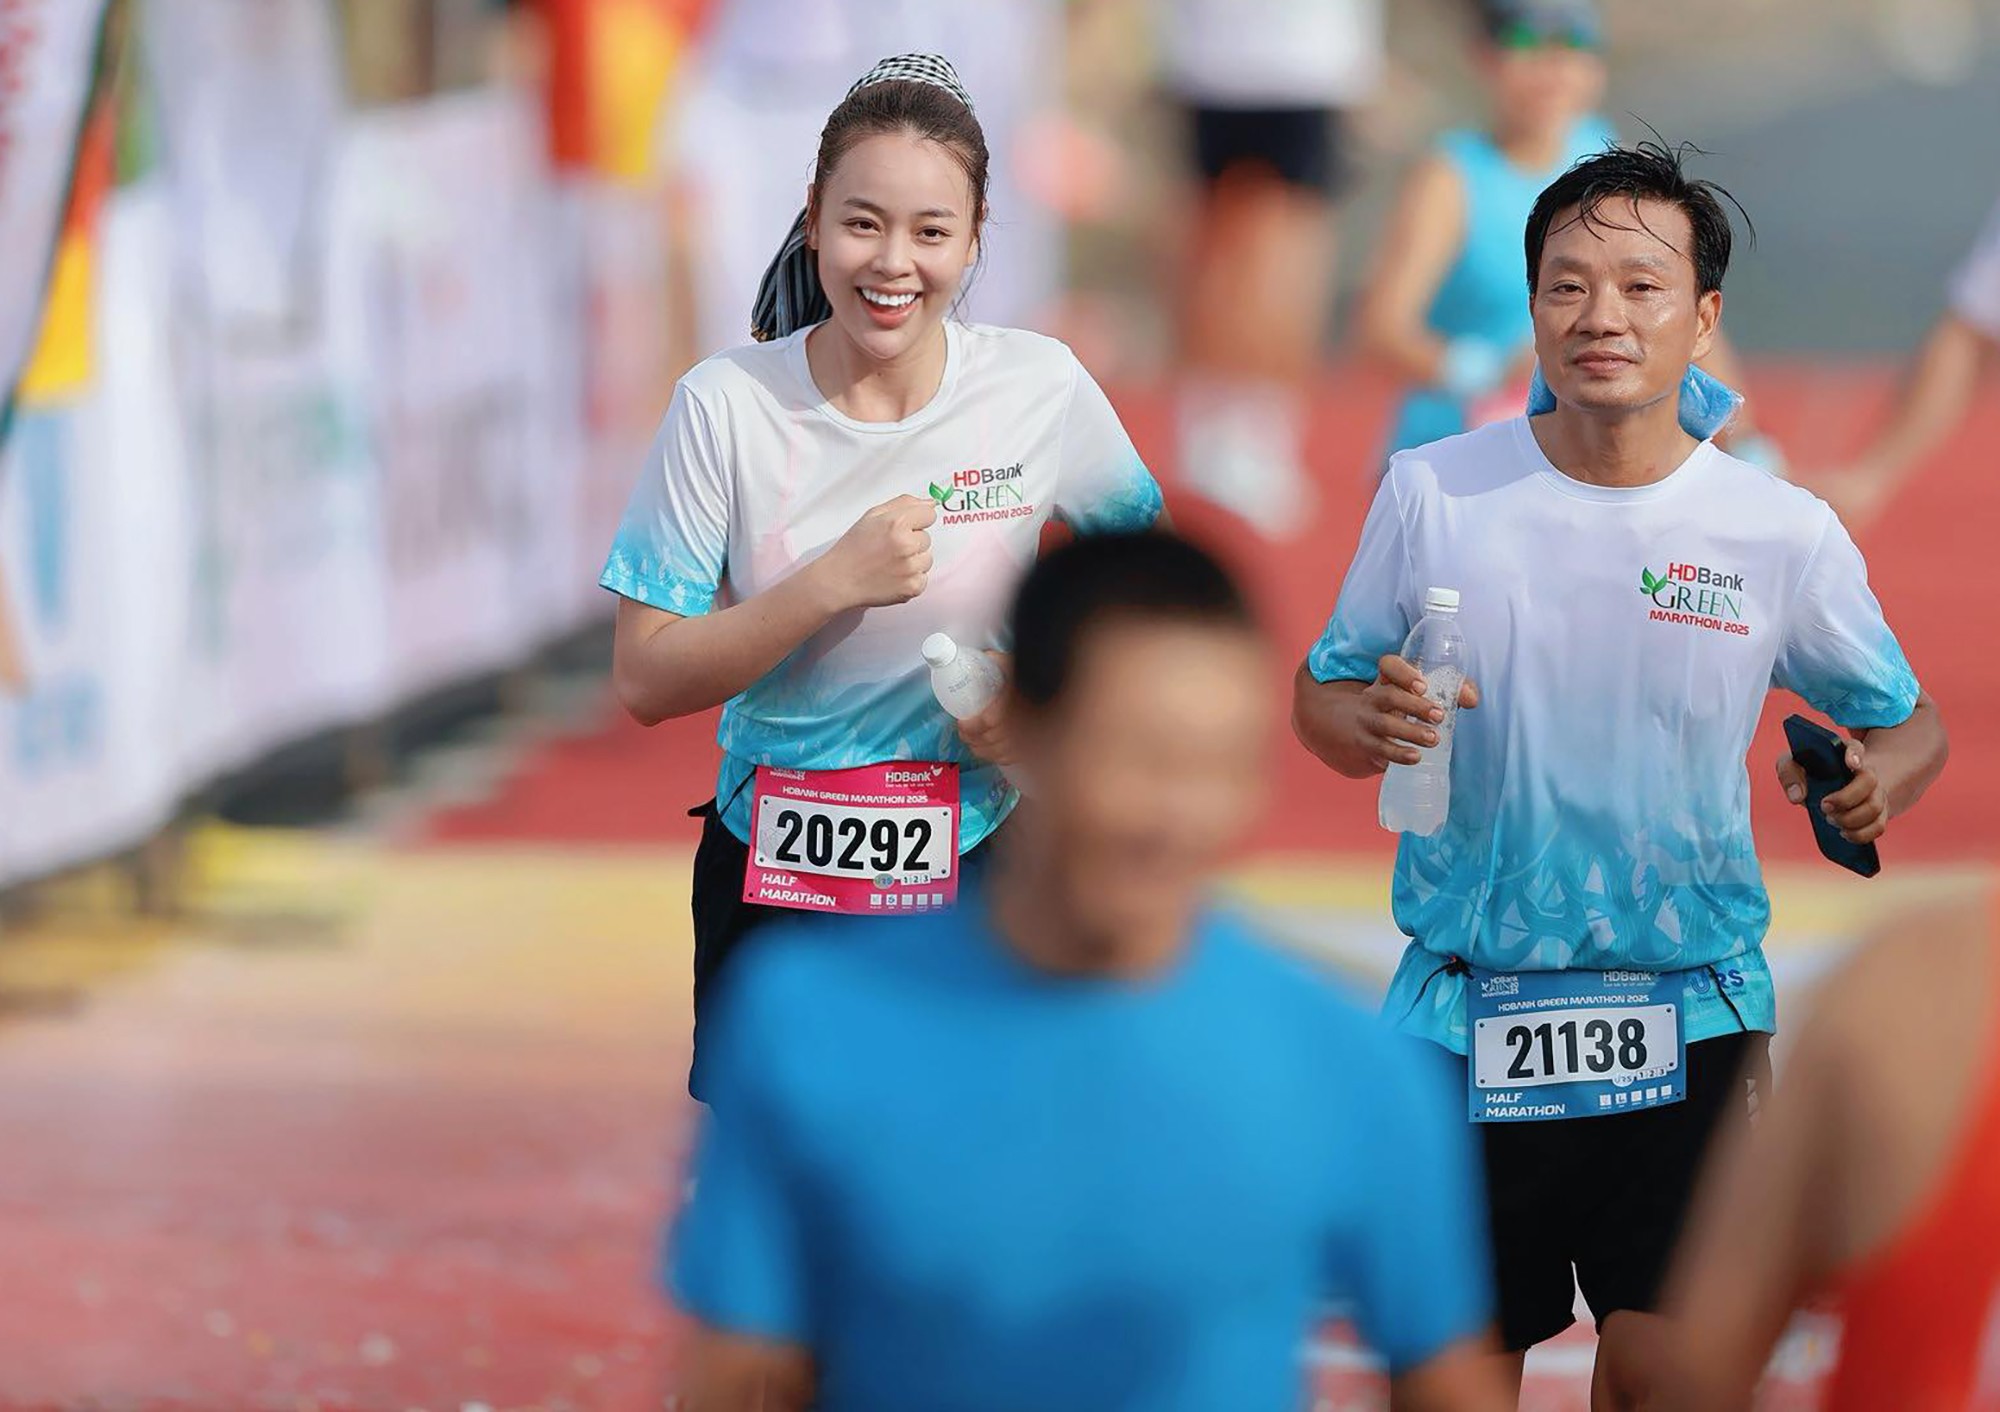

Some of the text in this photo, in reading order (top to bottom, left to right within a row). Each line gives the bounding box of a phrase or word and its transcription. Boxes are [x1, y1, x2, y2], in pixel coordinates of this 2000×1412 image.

[954, 463, 1023, 487] HDBank
[941, 482, 1024, 512] GREEN
[943, 505, 1034, 525] MARATHON 2025
[1668, 562, 1744, 592] HDBank
[1651, 580, 1742, 619] GREEN
[1649, 610, 1750, 635] MARATHON 2025
[885, 771, 931, 782] HDBank
[782, 785, 928, 804] HDBANK GREEN MARATHON 2025
[776, 810, 932, 872] 20292
[761, 873, 798, 887] HALF
[759, 887, 836, 906] MARATHON
[1603, 970, 1651, 982] HDBank
[1498, 994, 1649, 1012] HDBANK GREEN MARATHON 2025
[1505, 1019, 1648, 1079] 21138
[1485, 1092, 1523, 1104] HALF
[1485, 1104, 1565, 1118] MARATHON
